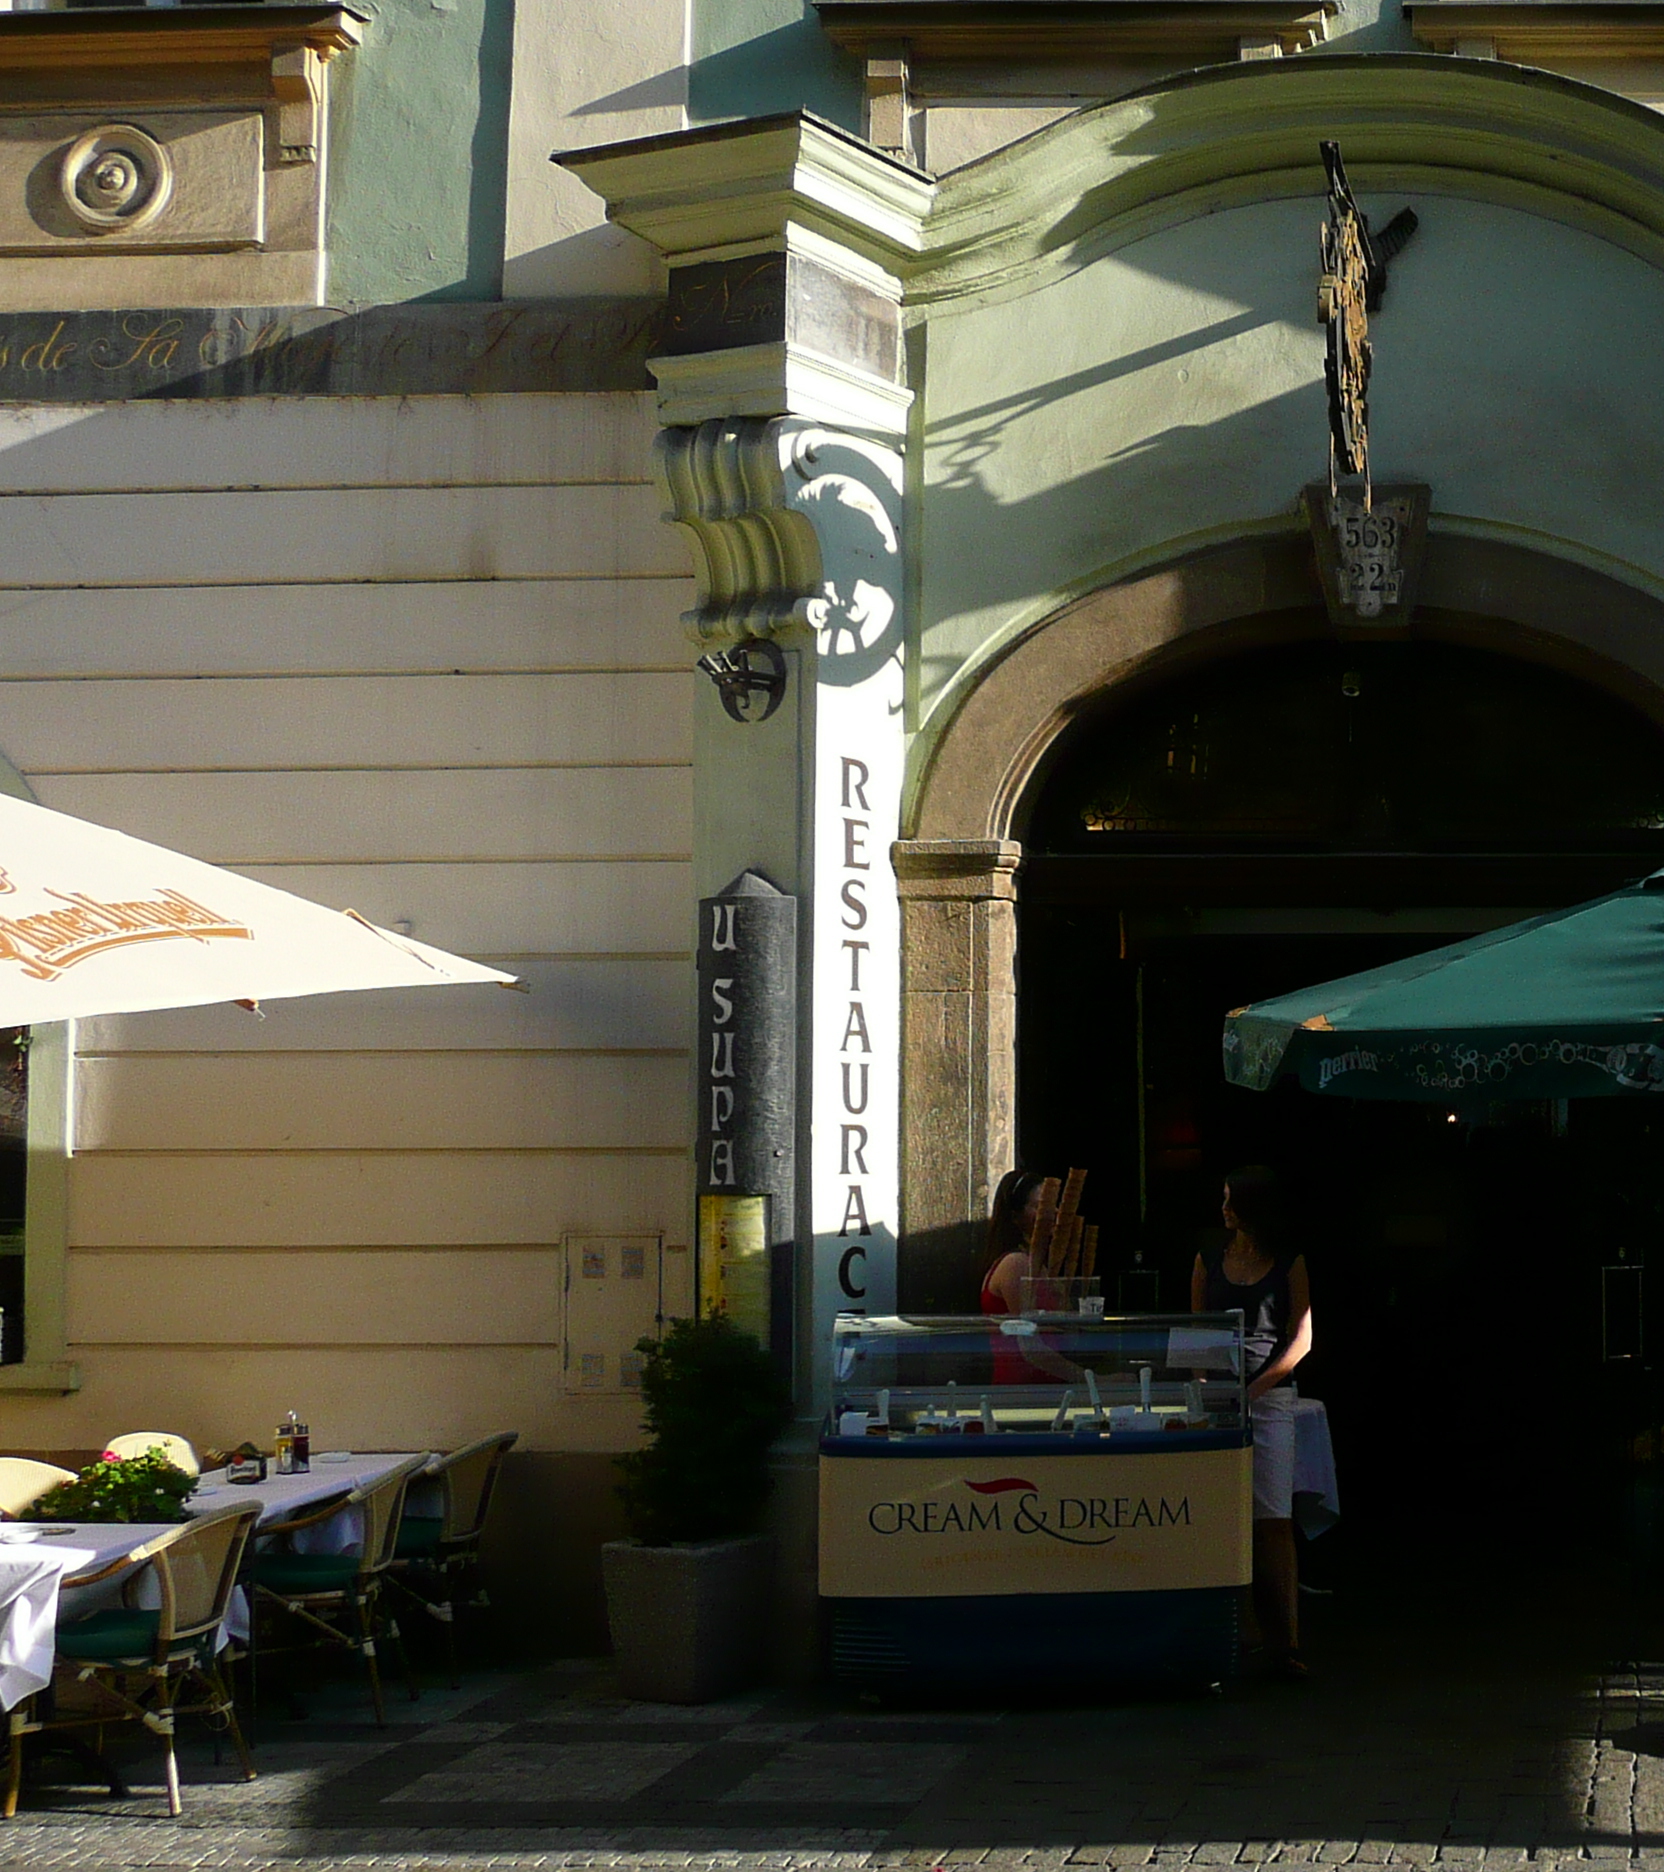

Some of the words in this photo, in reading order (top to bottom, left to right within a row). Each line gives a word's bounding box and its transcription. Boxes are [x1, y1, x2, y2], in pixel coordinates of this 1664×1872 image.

[21, 320, 77, 372] de
[1345, 516, 1397, 549] 563
[1350, 562, 1388, 592] 22
[838, 755, 873, 1315] RESTAURAC
[868, 1501, 1002, 1535] CREAM
[1058, 1496, 1193, 1530] DREAM
